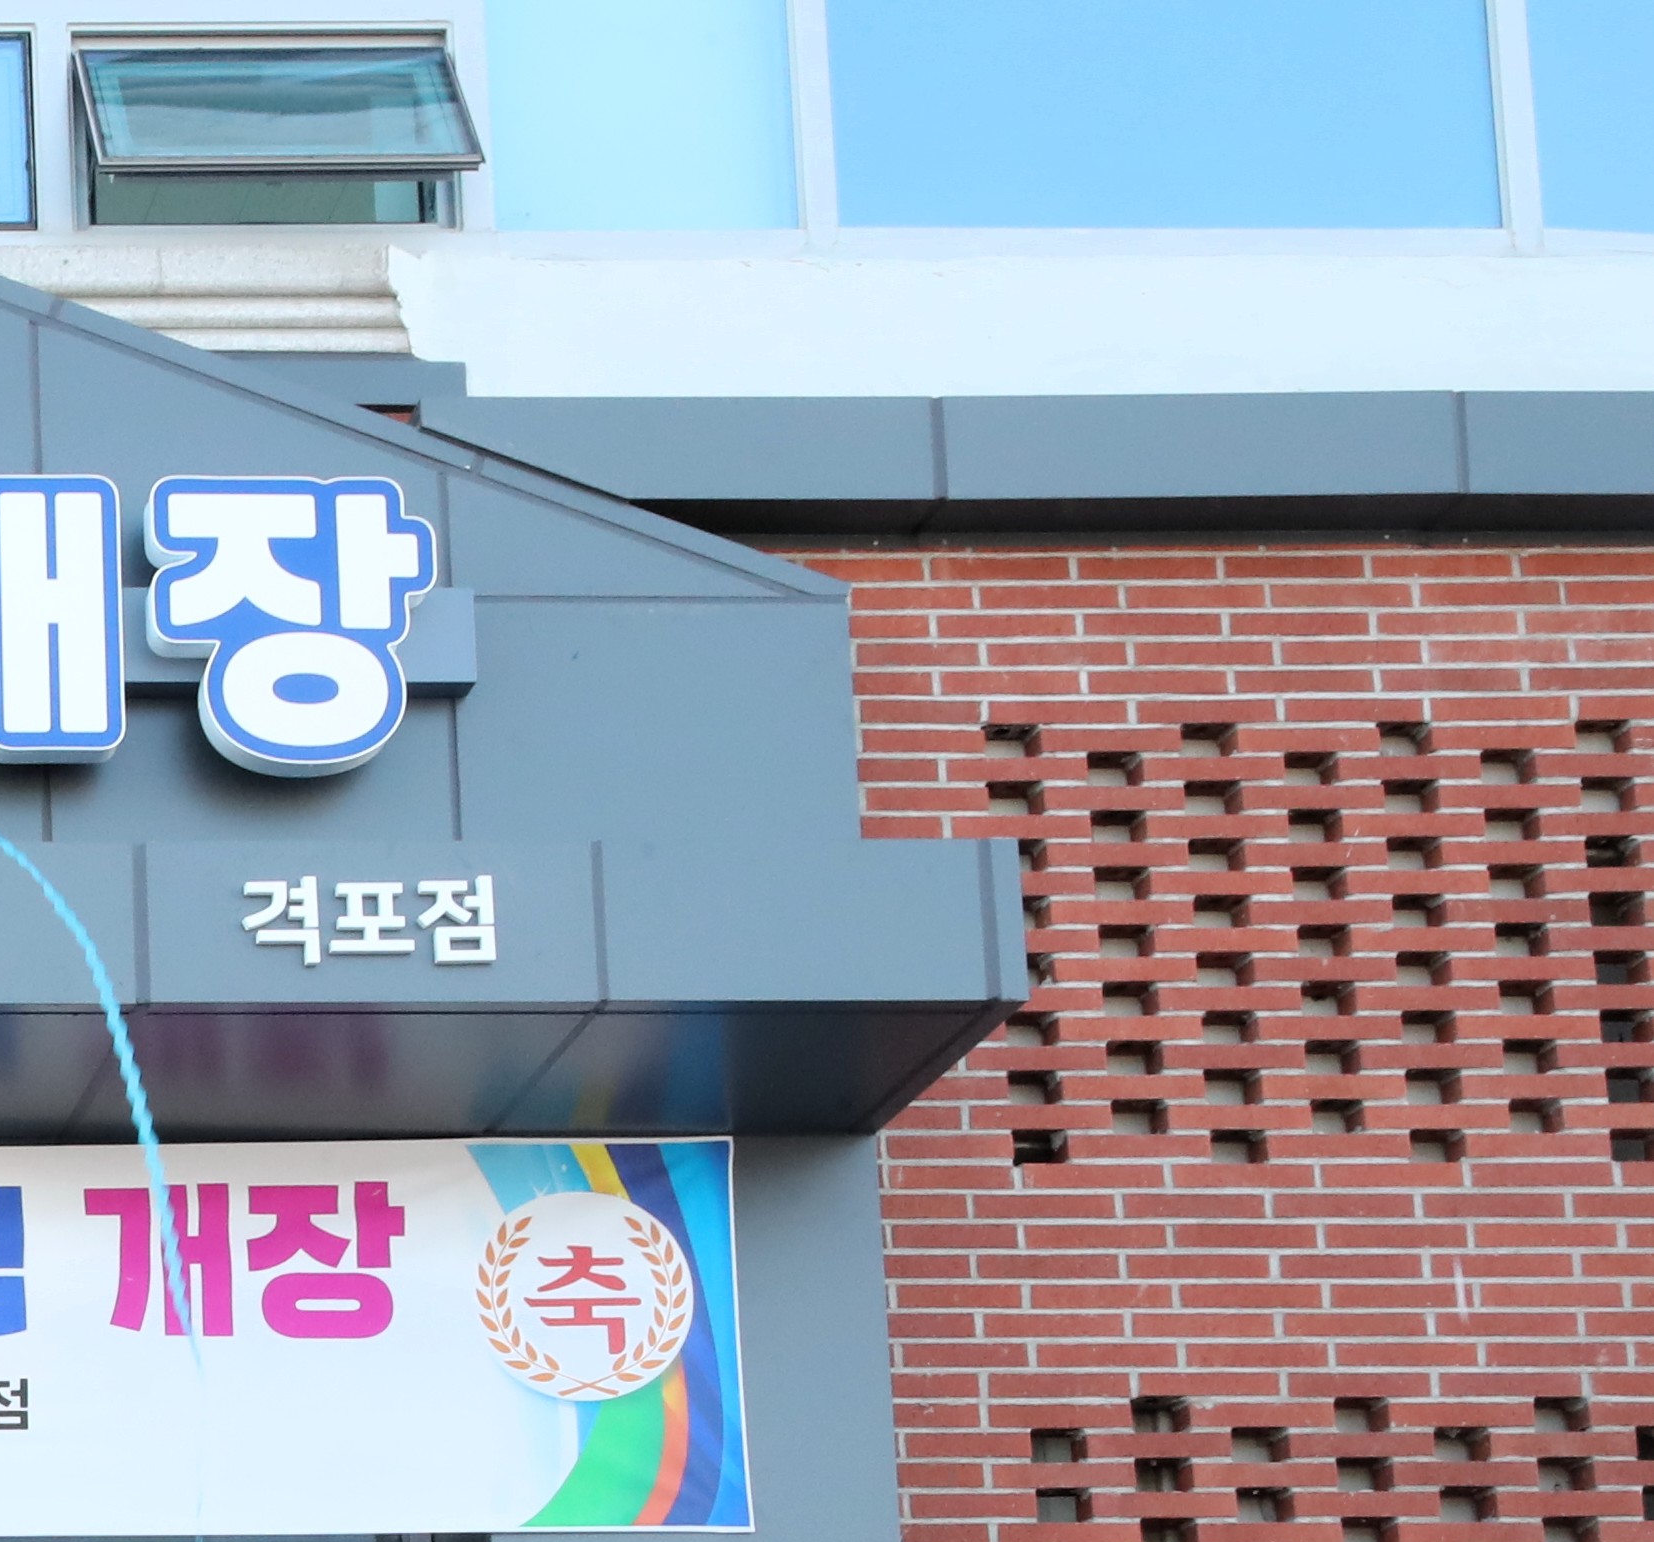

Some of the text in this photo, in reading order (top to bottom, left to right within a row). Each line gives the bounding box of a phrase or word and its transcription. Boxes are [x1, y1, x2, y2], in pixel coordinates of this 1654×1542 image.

[240, 874, 498, 966] 격포점
[83, 1180, 406, 1339] 개장
[523, 1245, 642, 1355] 축
